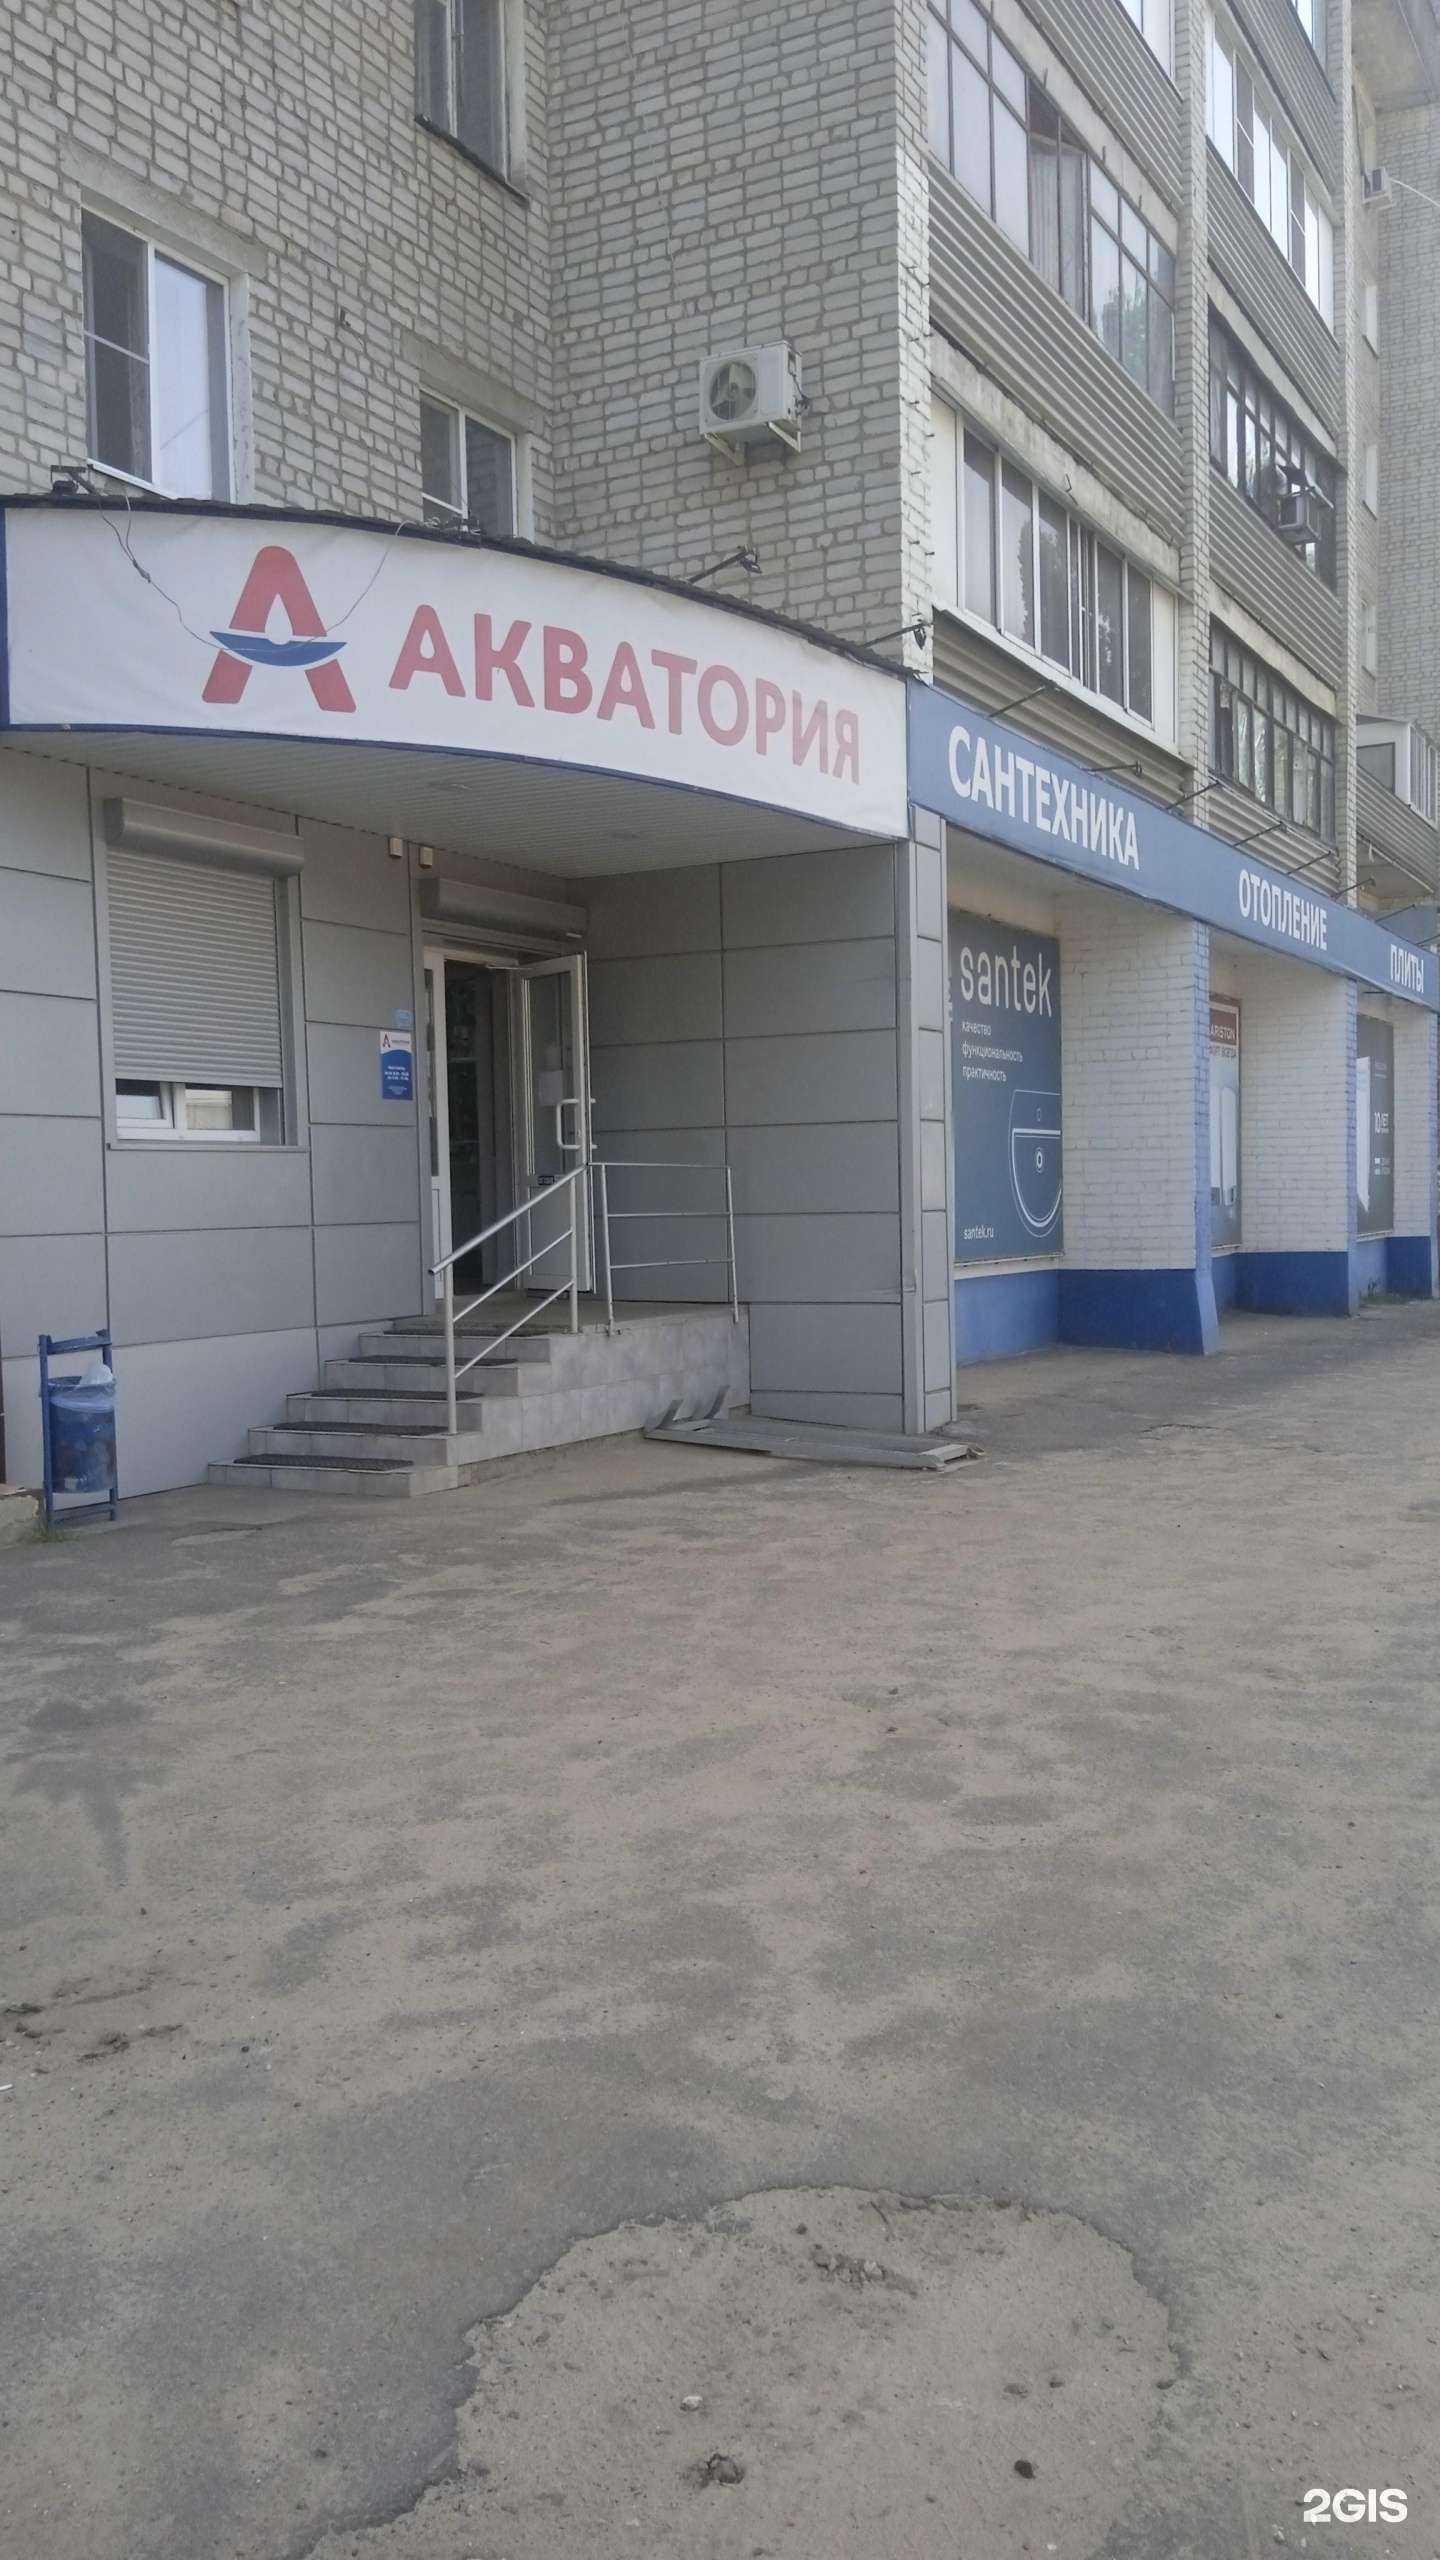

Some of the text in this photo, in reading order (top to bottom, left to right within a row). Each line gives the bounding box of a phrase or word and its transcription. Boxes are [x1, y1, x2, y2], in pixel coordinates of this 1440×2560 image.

[389, 605, 860, 785] АКВАТОРИЯ
[948, 725, 1140, 870] САНТЕХНИКА
[1239, 869, 1328, 950] ОТОПЛЕНИЕ
[960, 945, 1052, 1017] santek
[1390, 944, 1424, 993] ПЛИТЫ
[962, 1021, 992, 1036] качество
[962, 1040, 1024, 1063] функциональность
[962, 1066, 1007, 1082] практичность
[963, 1225, 994, 1240] santek.ru
